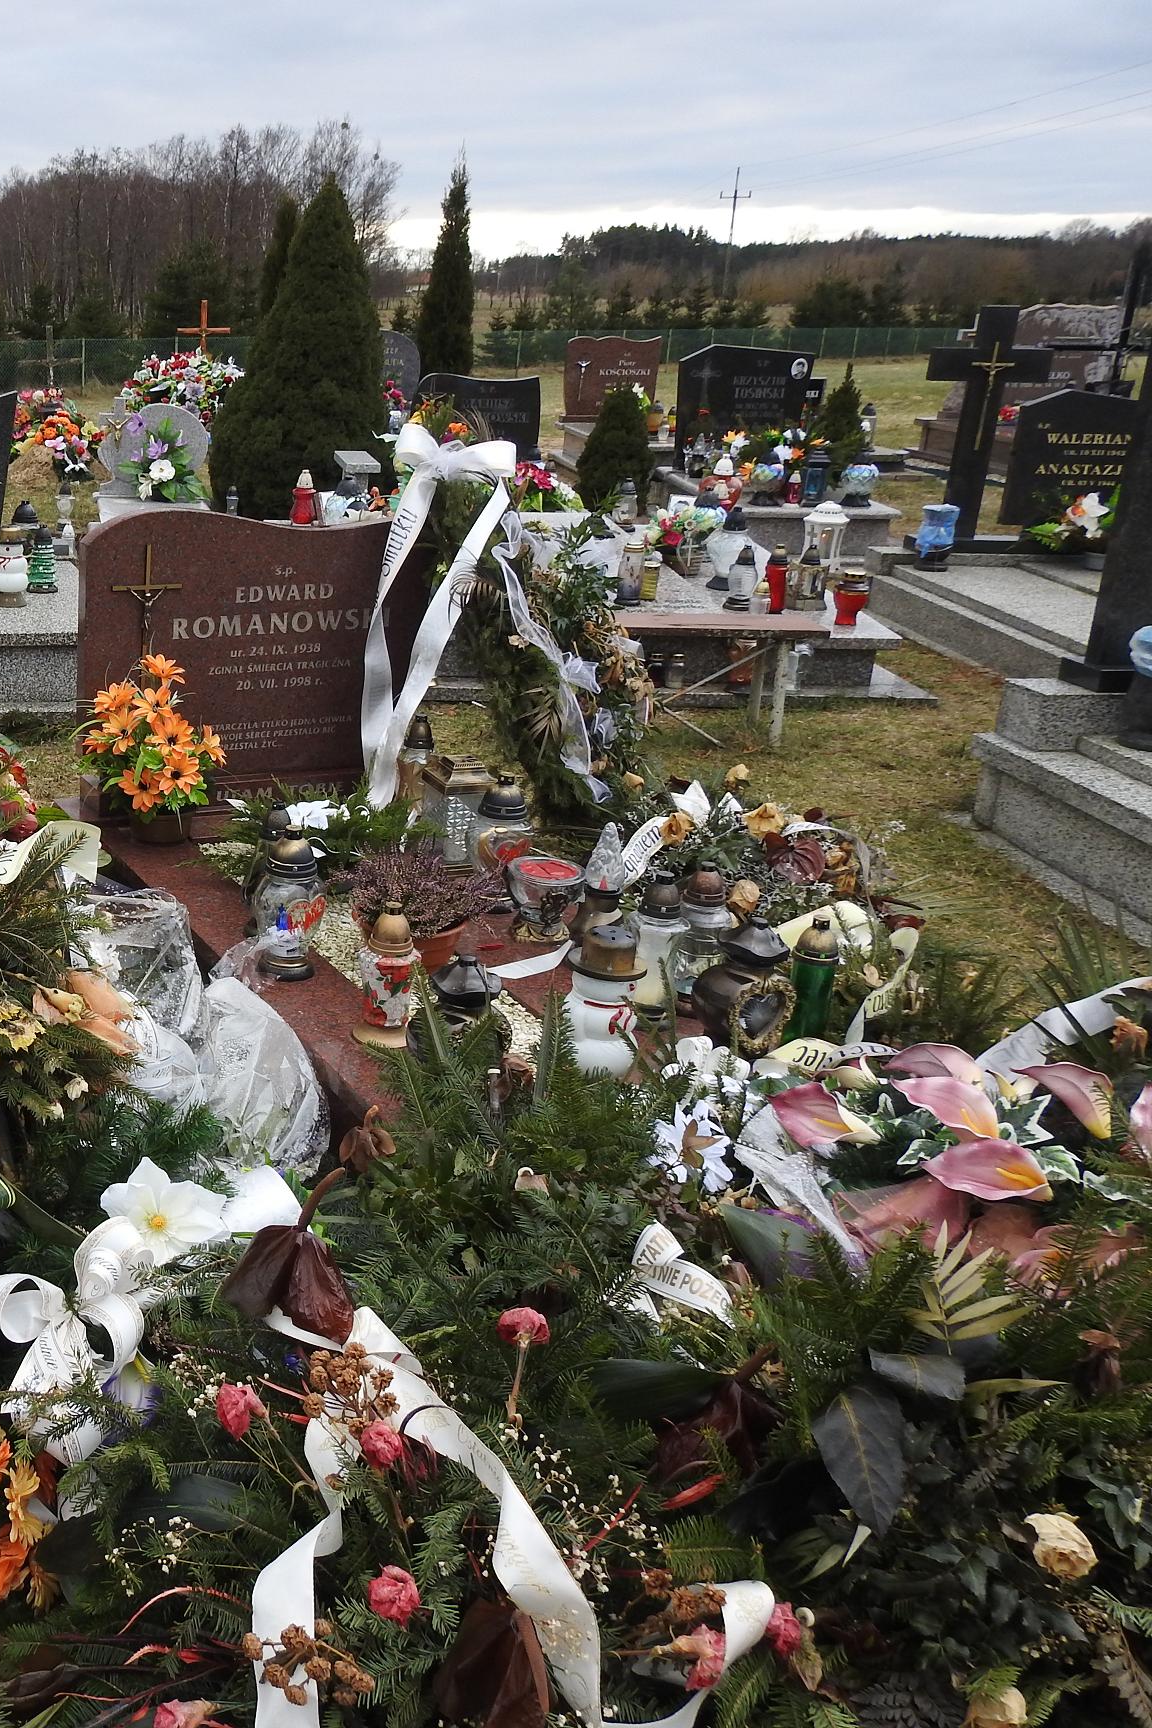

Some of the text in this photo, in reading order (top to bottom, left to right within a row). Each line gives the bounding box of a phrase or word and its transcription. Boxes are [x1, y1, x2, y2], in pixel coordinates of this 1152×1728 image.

[235, 583, 335, 604] EDWARD
[230, 643, 321, 659] ur. 24. IX. 1938
[236, 680, 254, 692] 20.
[259, 679, 278, 690] VII.
[283, 676, 311, 688] 1998
[261, 719, 288, 728] TYLKO
[290, 717, 317, 727] JEDNA
[245, 730, 271, 740] SERCE
